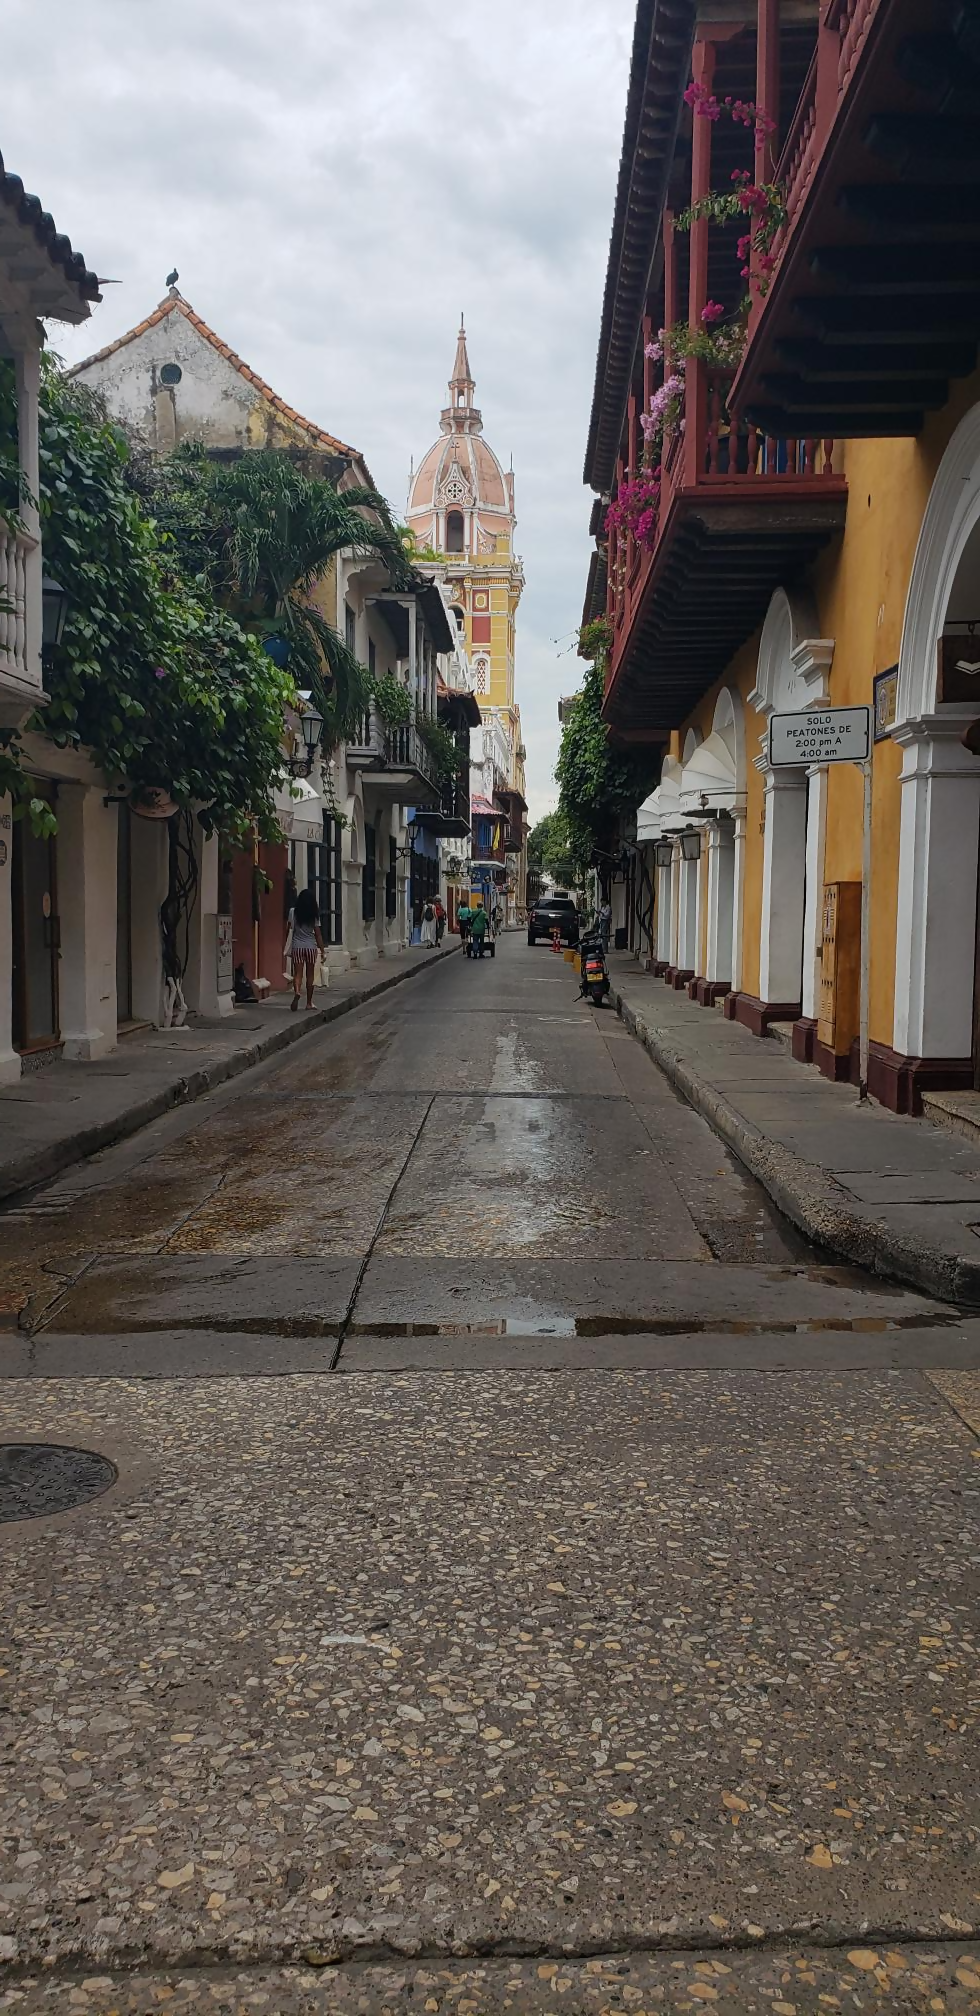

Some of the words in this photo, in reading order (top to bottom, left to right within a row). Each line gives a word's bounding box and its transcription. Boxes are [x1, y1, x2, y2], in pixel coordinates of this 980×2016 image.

[807, 716, 832, 725] SOLO
[786, 727, 836, 738] PEATONES
[839, 725, 852, 733] DE
[795, 739, 816, 748] 2:00
[819, 739, 832, 748] pm
[835, 737, 842, 745] A
[800, 749, 822, 758] 4:00
